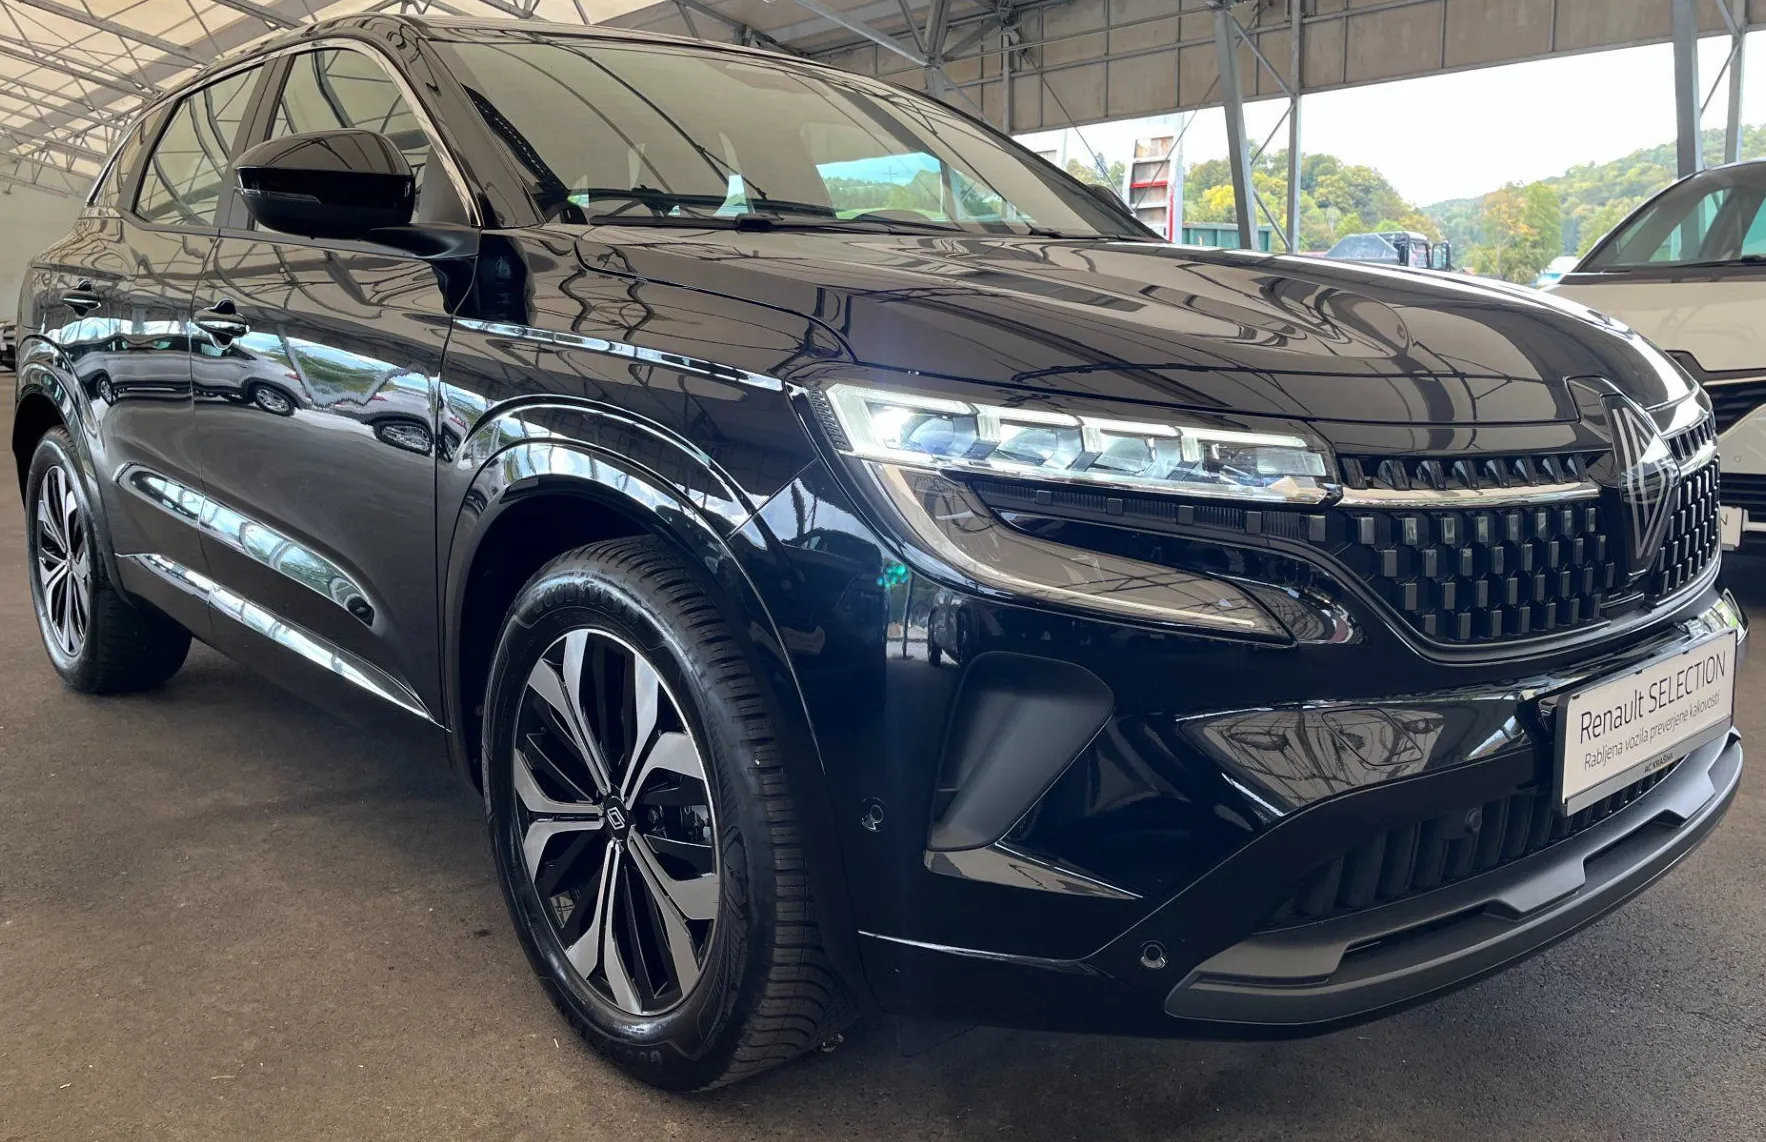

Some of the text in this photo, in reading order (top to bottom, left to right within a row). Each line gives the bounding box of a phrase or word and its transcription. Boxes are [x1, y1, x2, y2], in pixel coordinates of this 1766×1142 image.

[1580, 650, 1726, 744] Renault SELECTION
[1584, 742, 1623, 771] Rabljena
[1625, 727, 1649, 752] vozila
[1689, 688, 1720, 717] kakovosti
